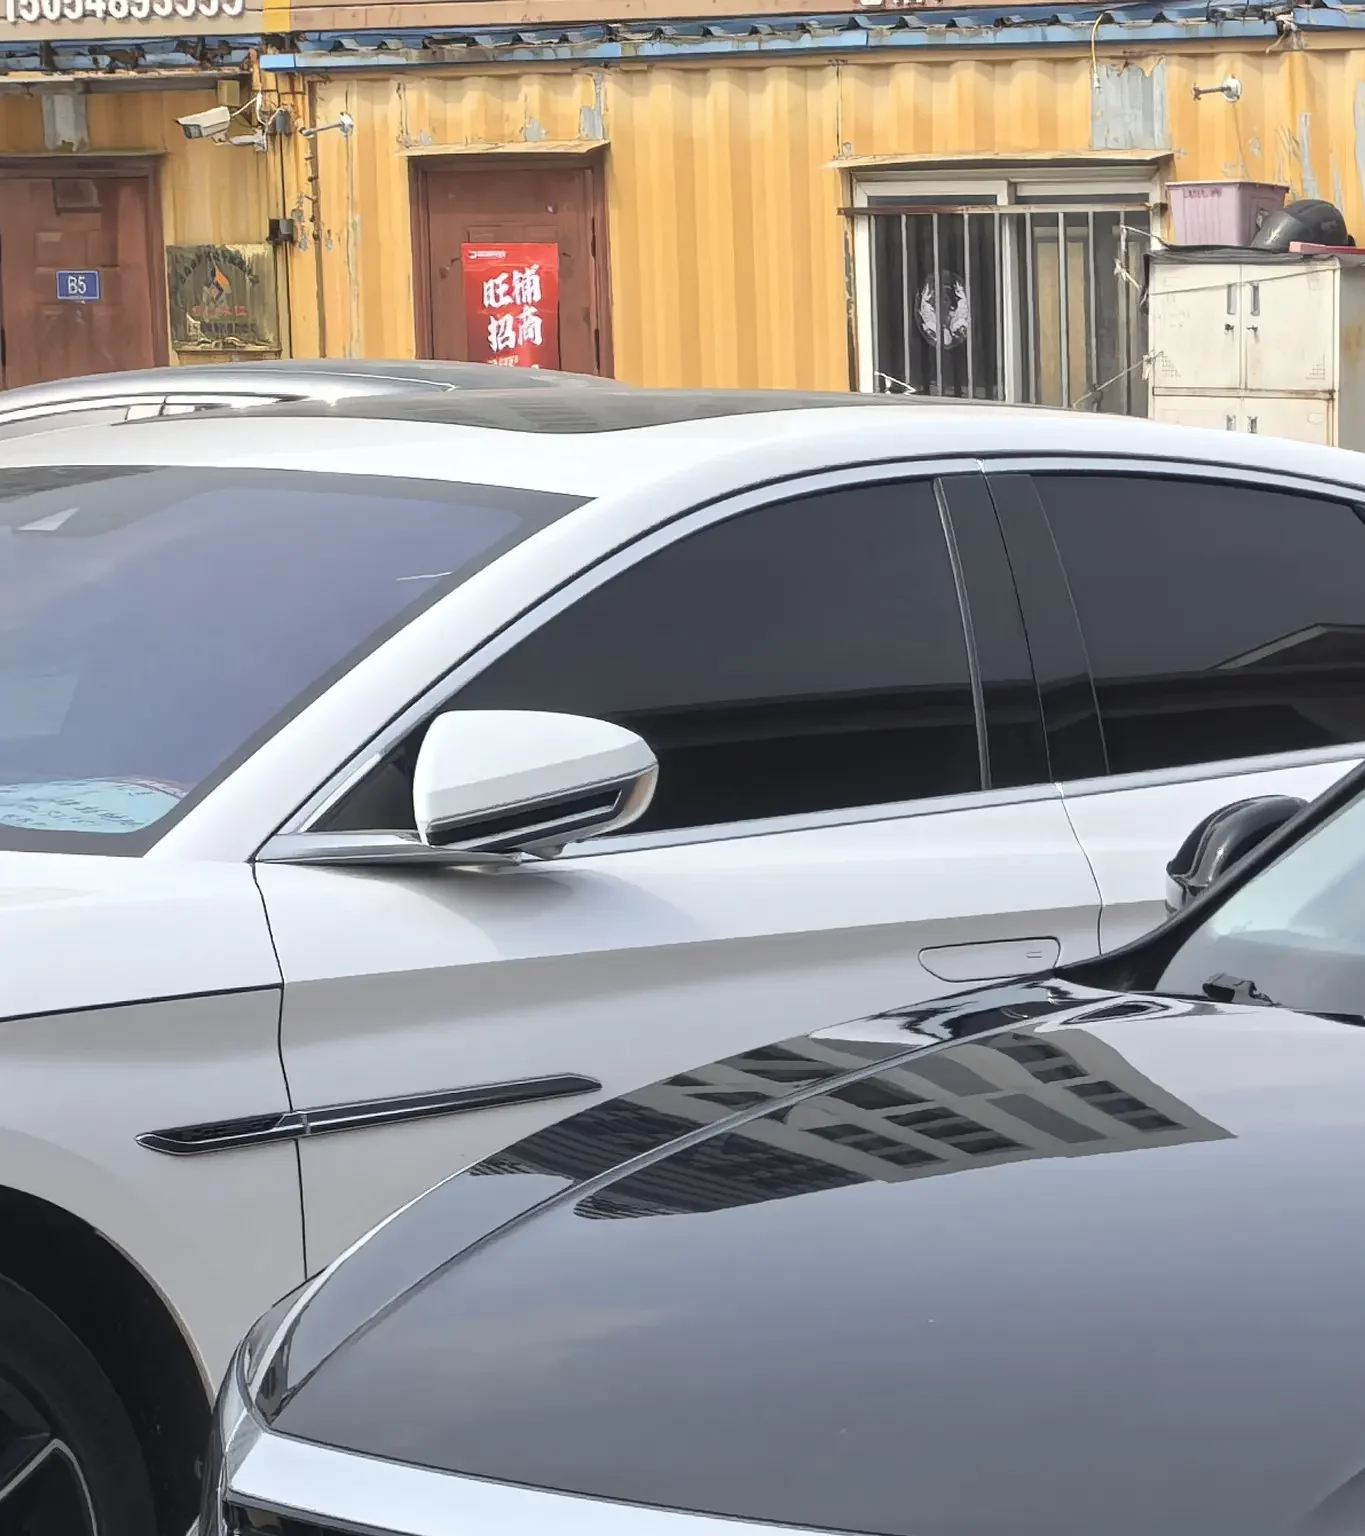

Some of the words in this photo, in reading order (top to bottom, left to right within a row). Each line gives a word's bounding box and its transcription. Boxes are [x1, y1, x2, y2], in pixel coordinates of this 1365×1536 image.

[68, 275, 86, 294] B5
[483, 264, 541, 308] 旺铺
[487, 305, 542, 352] 招商
